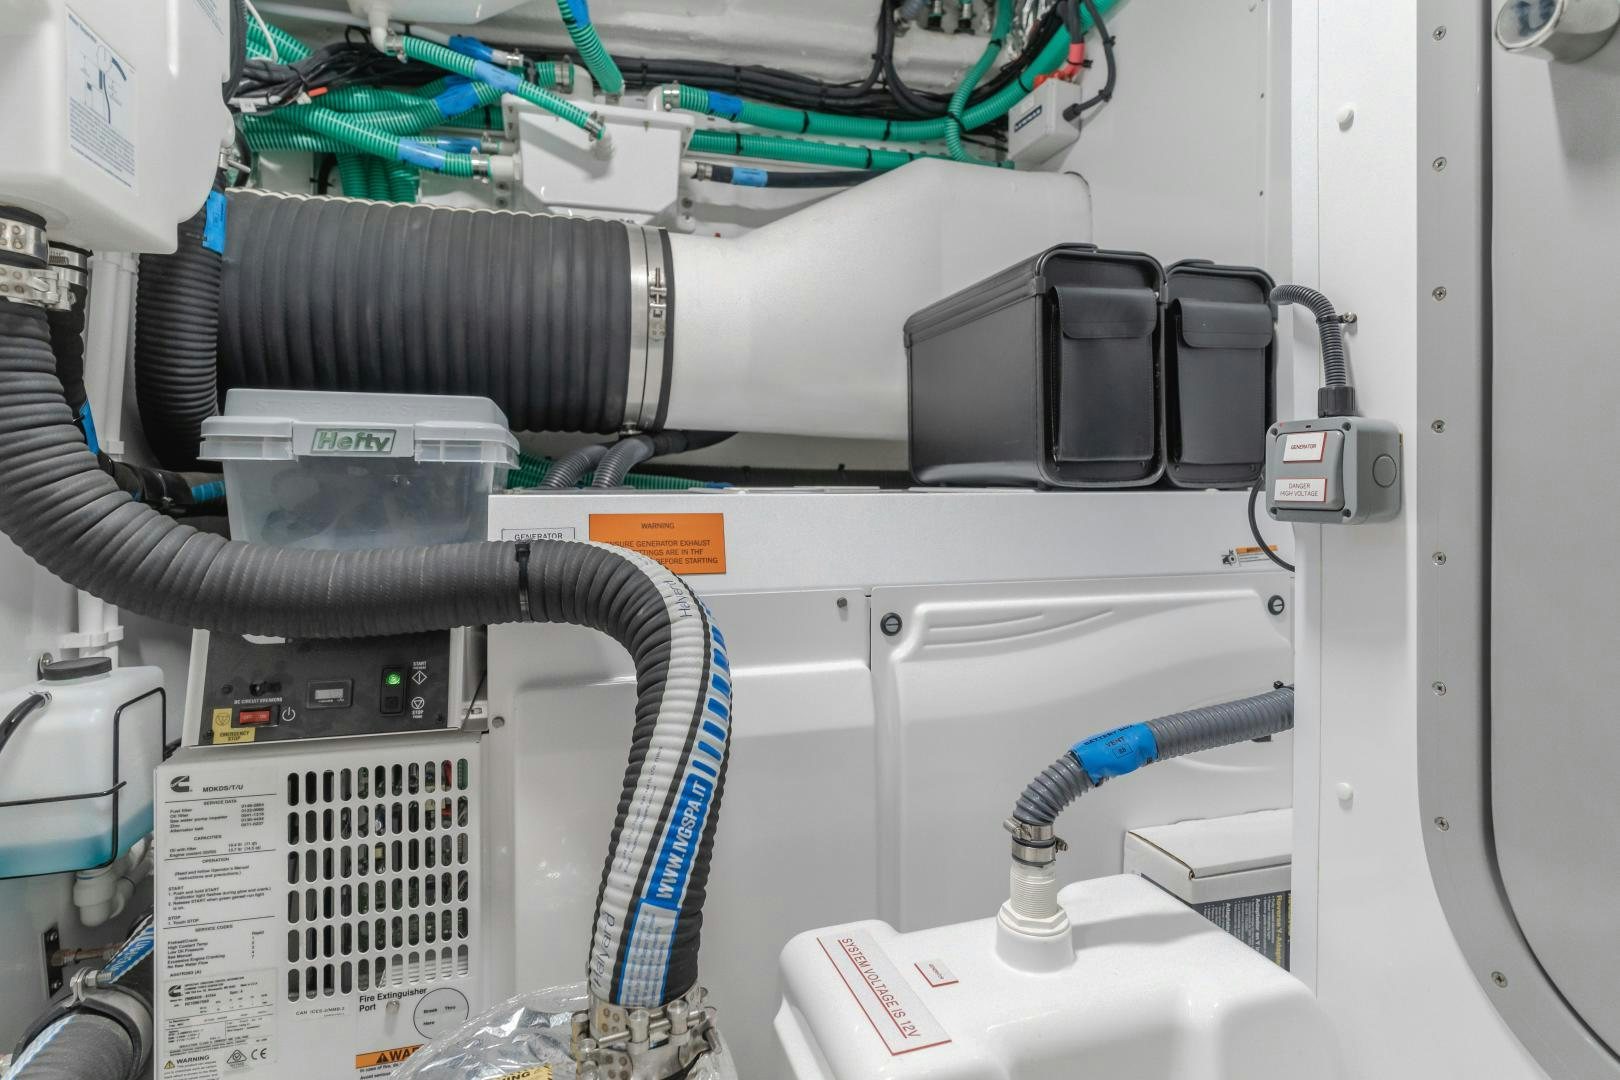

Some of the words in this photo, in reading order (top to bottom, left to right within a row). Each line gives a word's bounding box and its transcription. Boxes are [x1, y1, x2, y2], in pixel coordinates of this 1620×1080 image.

[317, 431, 390, 452] Hefty
[203, 784, 243, 792] MDKDS/T/U
[656, 781, 708, 900] WWW.IVGSPA.IT
[593, 912, 616, 988] Halyard
[359, 995, 375, 1003] Fire
[377, 988, 428, 1001] Extinguisher
[842, 937, 871, 968] SYSTEM
[864, 966, 899, 1009] VOLTAGE
[894, 1008, 906, 1019] IS
[900, 1020, 920, 1037] 12V
[359, 1004, 376, 1012] Port
[177, 1055, 209, 1064] WARNING
